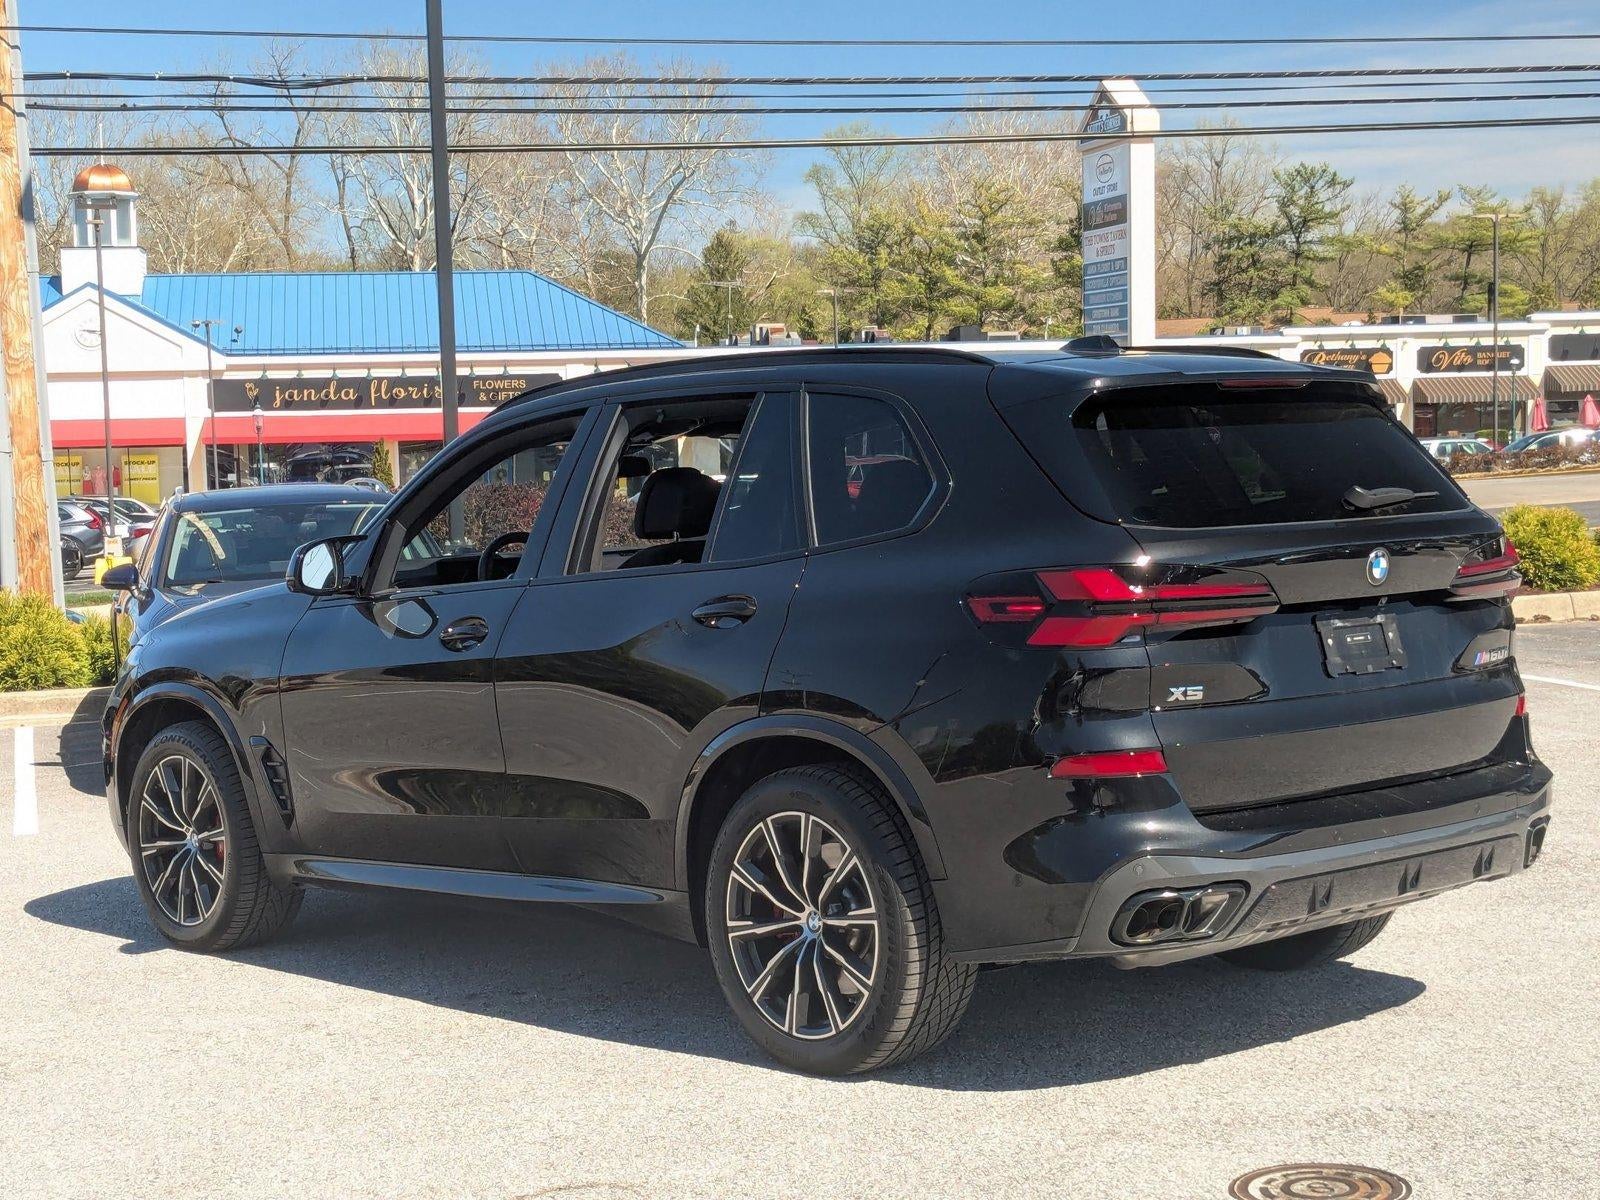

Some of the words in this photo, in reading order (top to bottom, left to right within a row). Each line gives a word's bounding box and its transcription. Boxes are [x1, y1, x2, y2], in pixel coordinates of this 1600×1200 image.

[1431, 348, 1473, 371] Vito
[473, 379, 526, 390] FLOWERS
[273, 380, 358, 408] janda
[370, 379, 443, 406] floris
[479, 391, 487, 401] &
[1166, 685, 1204, 702] X5
